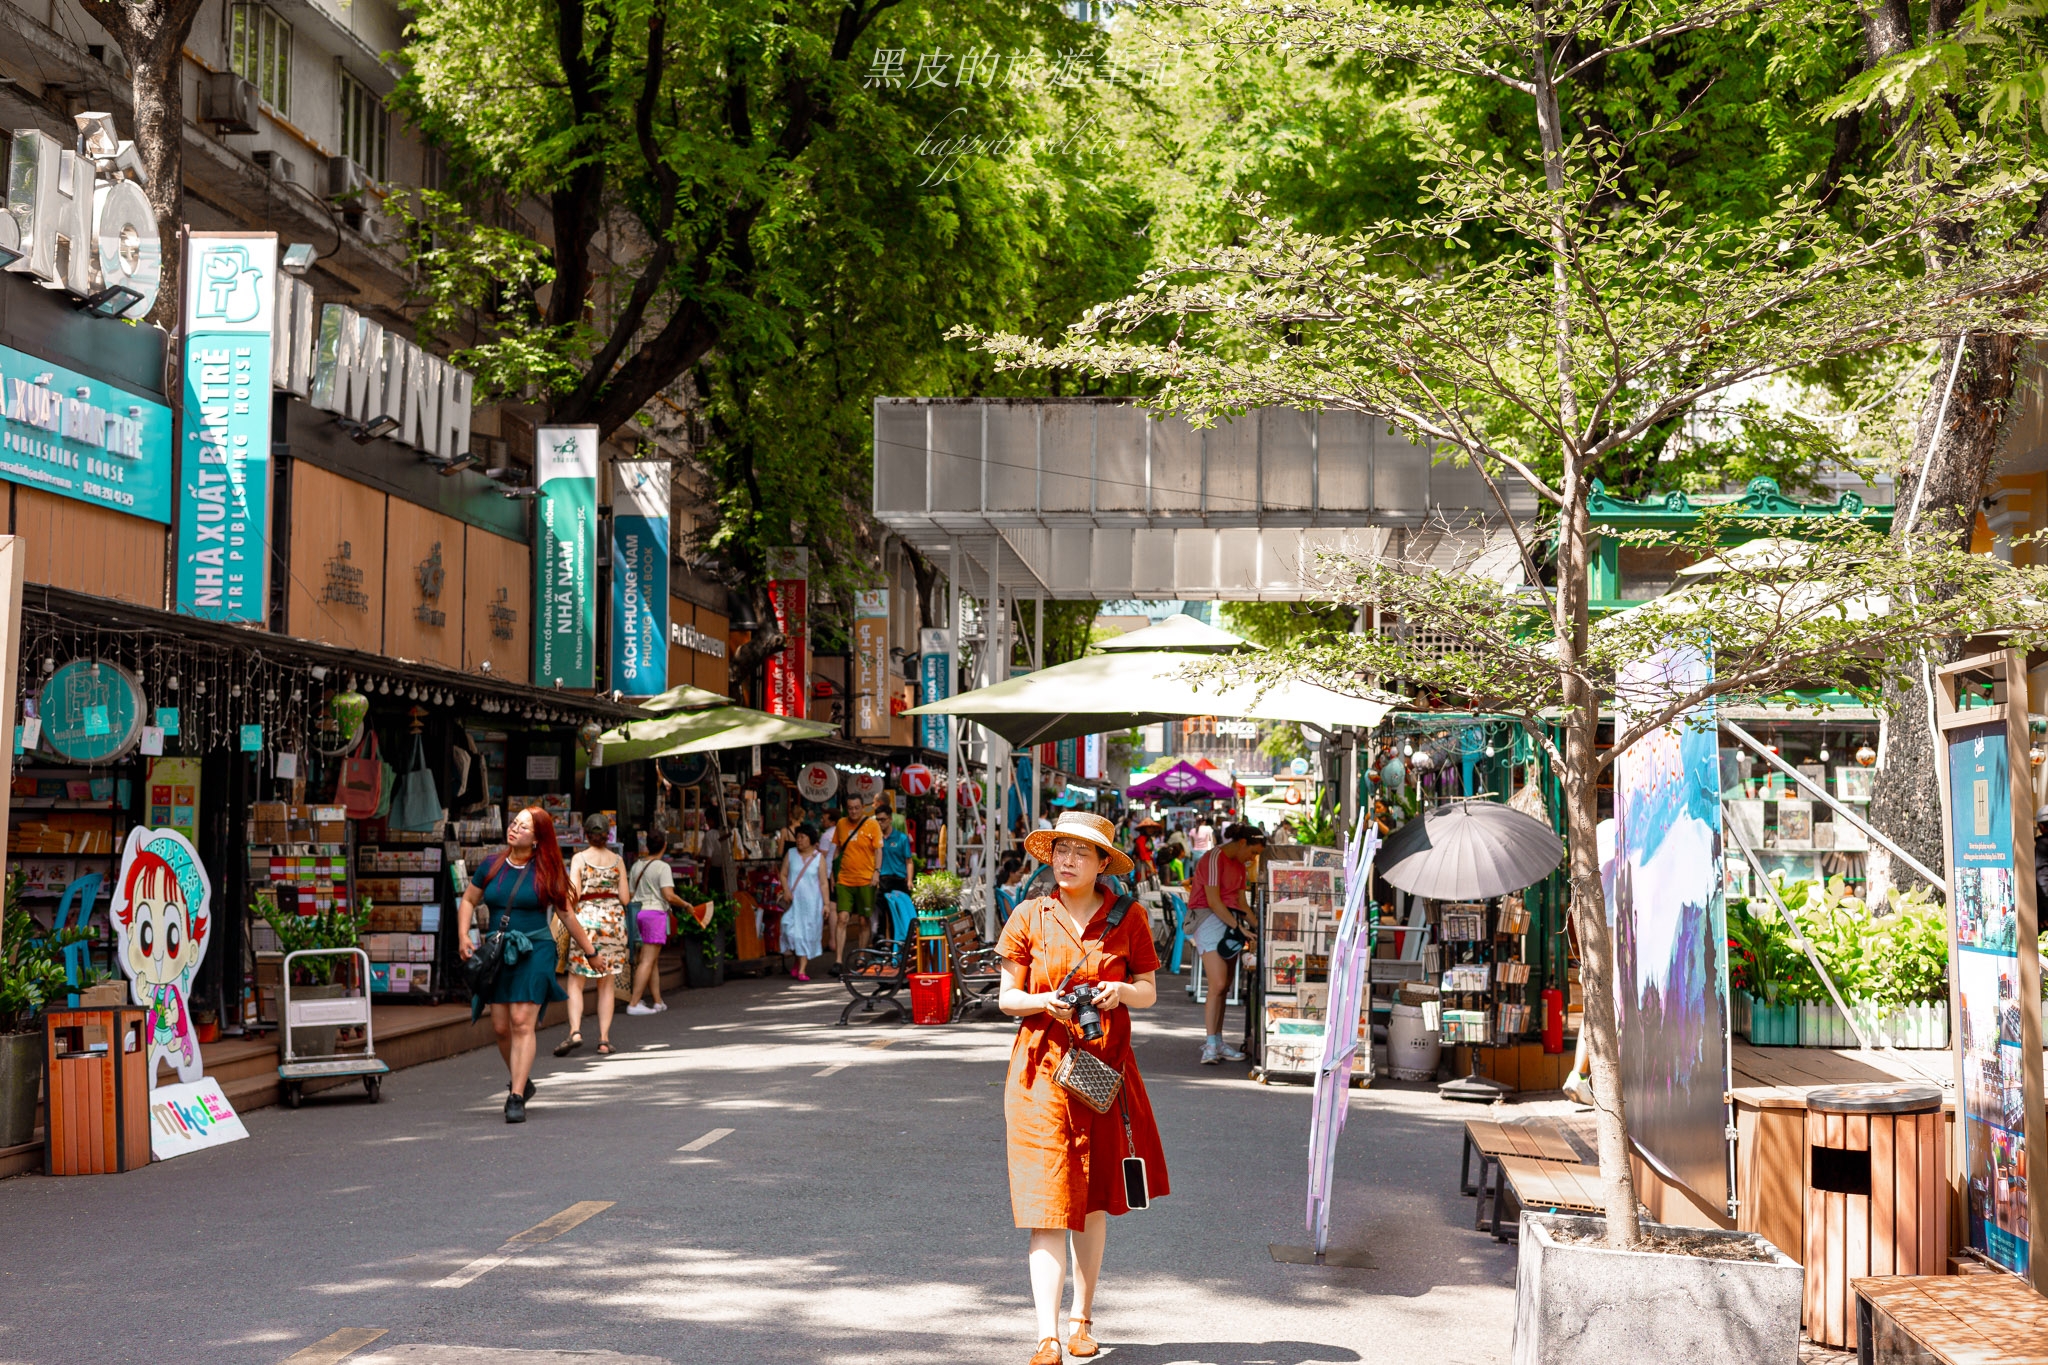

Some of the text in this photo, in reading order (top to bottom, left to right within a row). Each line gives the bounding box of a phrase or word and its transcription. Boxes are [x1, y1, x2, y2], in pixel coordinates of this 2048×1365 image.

[311, 303, 474, 460] MINH
[3, 431, 79, 471] PUBLISHING
[86, 456, 125, 483] HOUSE
[188, 348, 231, 607] NHÀ XUẤT BẢN TRẺ
[228, 347, 252, 610] TRE PUBLISHING HOUSE
[576, 520, 585, 580] Communications
[554, 541, 574, 633] NHÃ NAM
[622, 534, 638, 679] SÁCH PHƯƠNG NAM
[642, 547, 653, 668] PHUONG NAM BOOK
[576, 596, 586, 634] Publishing
[859, 624, 871, 647] HÀ
[543, 652, 552, 676] CÔNG
[544, 642, 552, 652] TY
[927, 658, 936, 678] SEN
[773, 666, 784, 695] XUẤT
[786, 672, 795, 702] DONG
[928, 680, 936, 703] HOA
[859, 688, 871, 730] SÁCH
[151, 1095, 216, 1140] miko!
